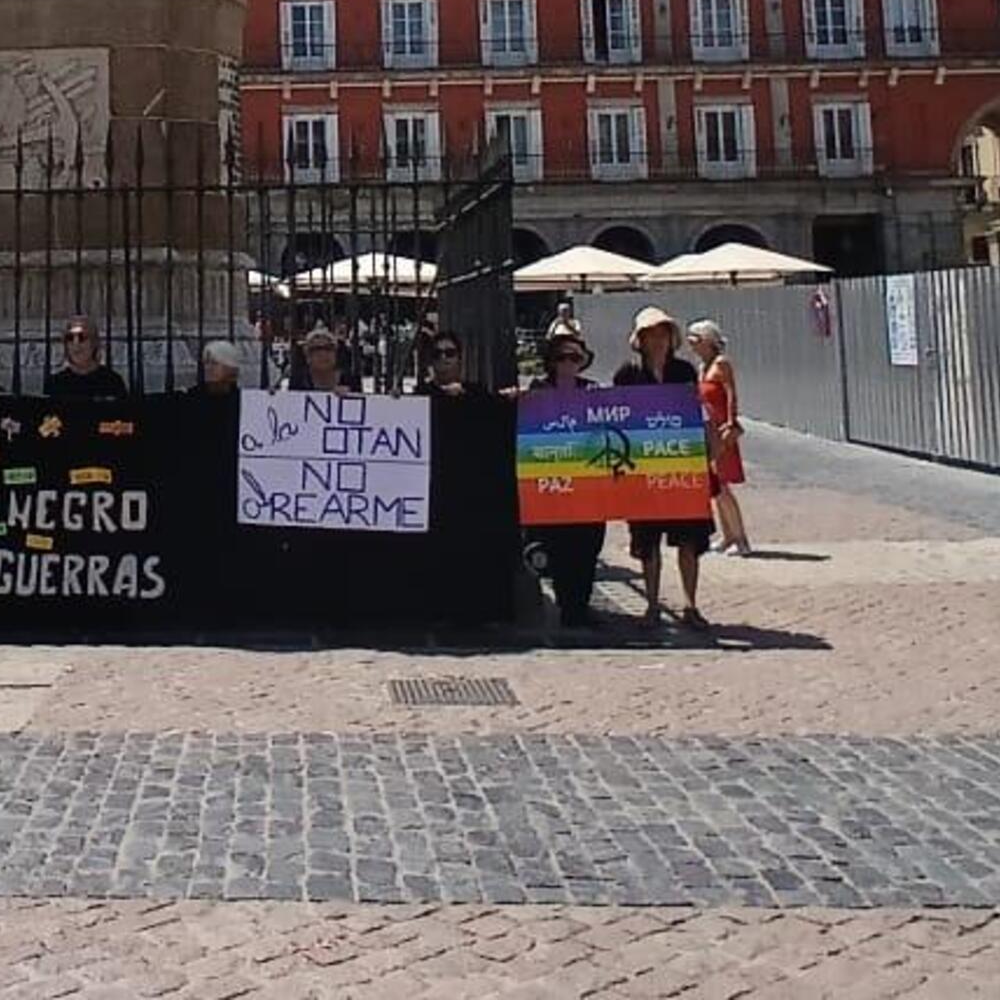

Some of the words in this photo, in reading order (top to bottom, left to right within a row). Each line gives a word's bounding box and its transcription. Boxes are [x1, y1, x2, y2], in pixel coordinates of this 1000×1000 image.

[304, 394, 367, 426] NO
[586, 405, 631, 424] МИР
[241, 433, 264, 451] a
[322, 427, 422, 459] OTAN
[643, 438, 692, 457] PACE
[302, 460, 367, 494] NO
[537, 476, 575, 494] PAZ
[7, 489, 148, 534] NEGRO
[269, 492, 425, 529] REARME
